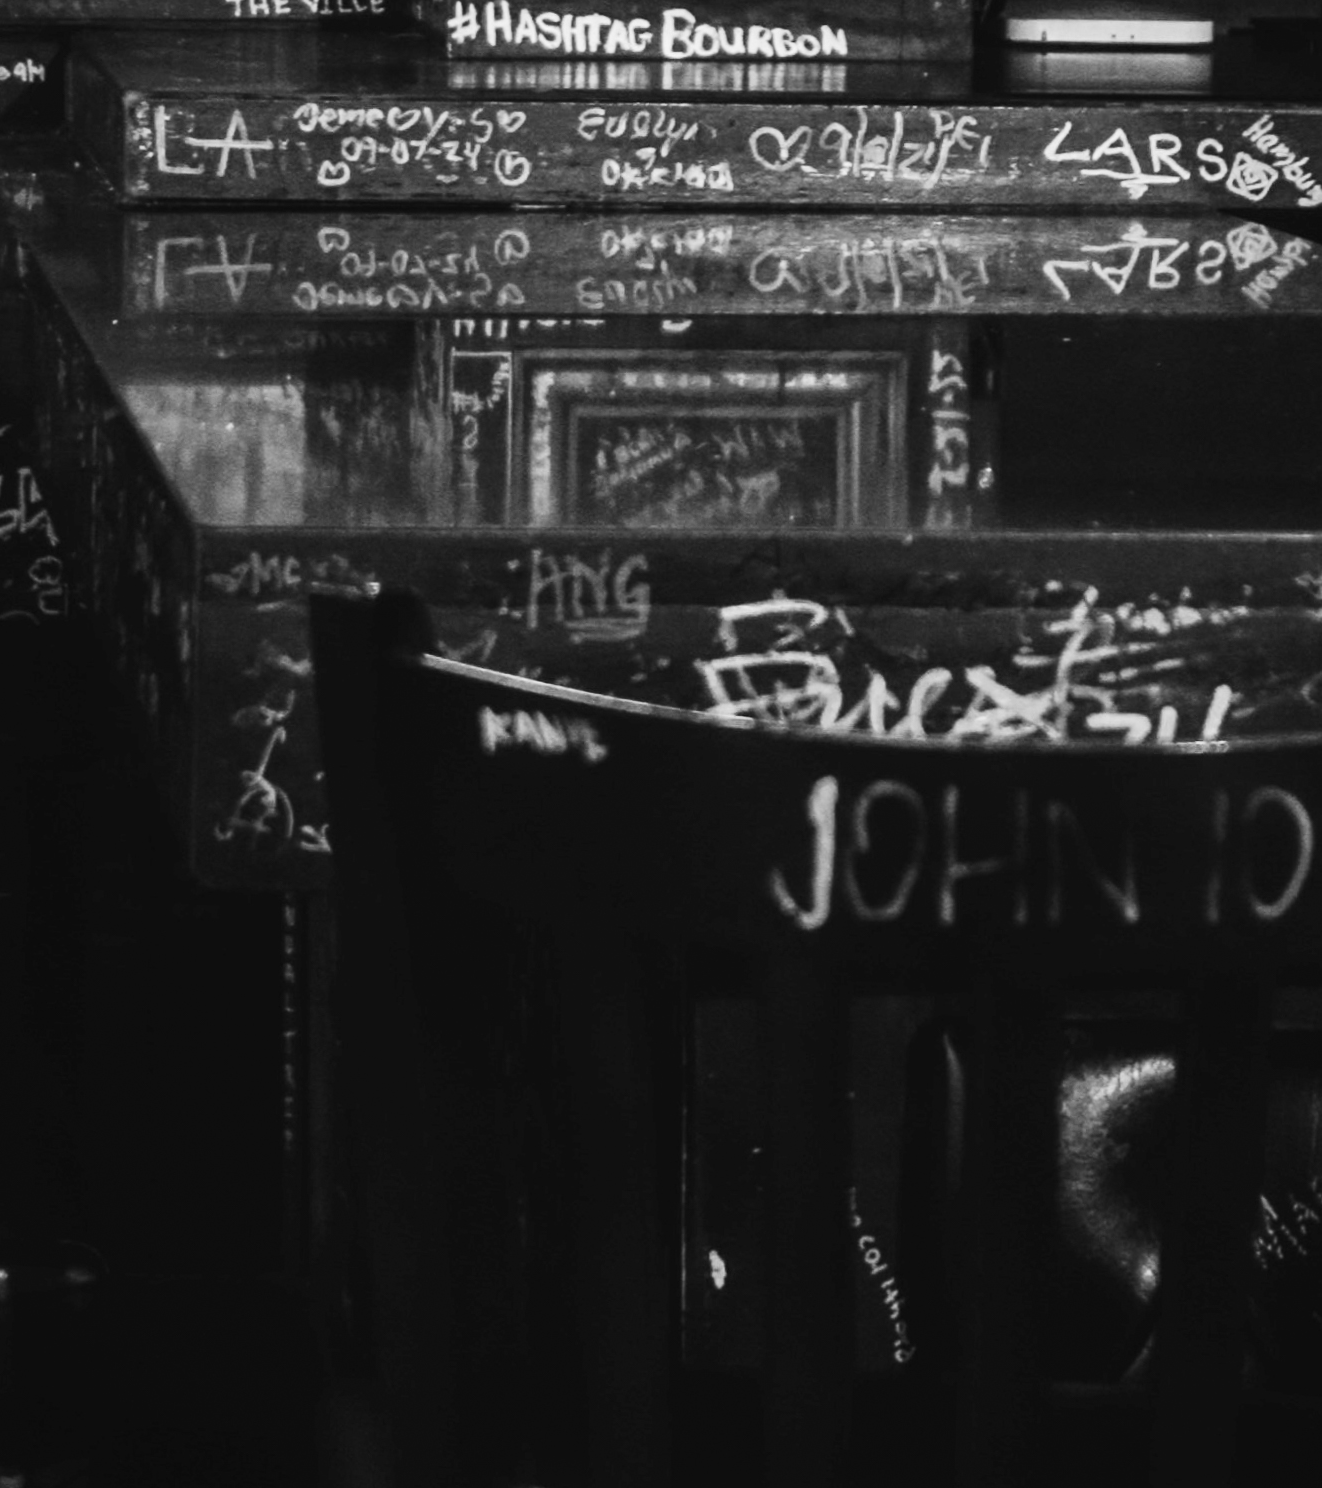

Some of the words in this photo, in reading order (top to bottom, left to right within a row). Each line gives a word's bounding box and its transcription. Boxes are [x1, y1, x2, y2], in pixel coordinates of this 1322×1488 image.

[449, 0, 654, 54] #HASHTAG
[1042, 121, 1229, 183] LARS
[768, 774, 1141, 931] JOHN
